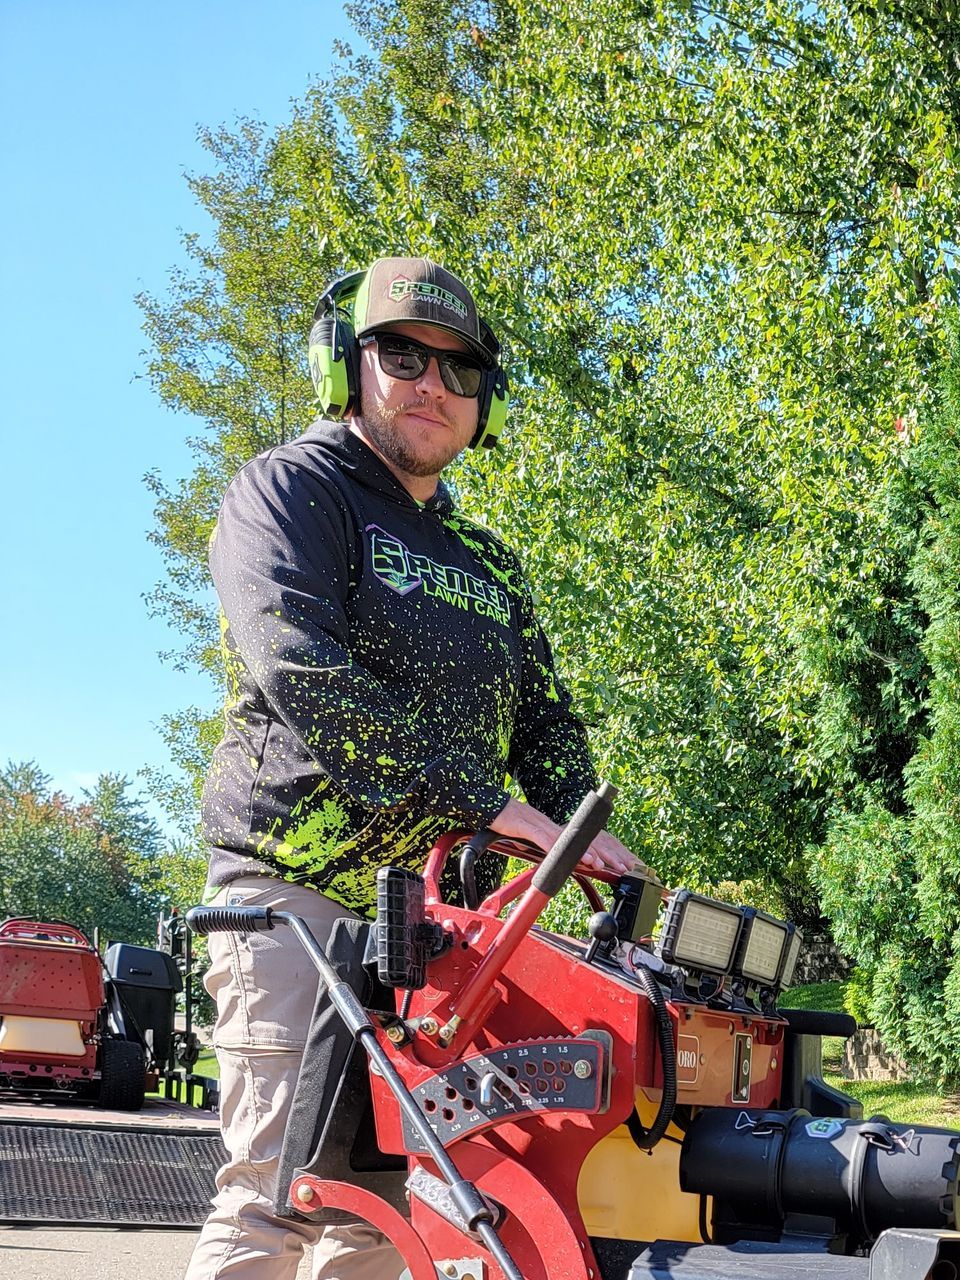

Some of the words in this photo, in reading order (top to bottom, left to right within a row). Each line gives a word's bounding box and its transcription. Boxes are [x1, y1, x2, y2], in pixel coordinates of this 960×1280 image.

[411, 294, 441, 305] LAWN
[422, 578, 469, 611] LAWN
[474, 600, 510, 628] CARE
[678, 1050, 696, 1068] ORO
[438, 1075, 449, 1083] 4.5
